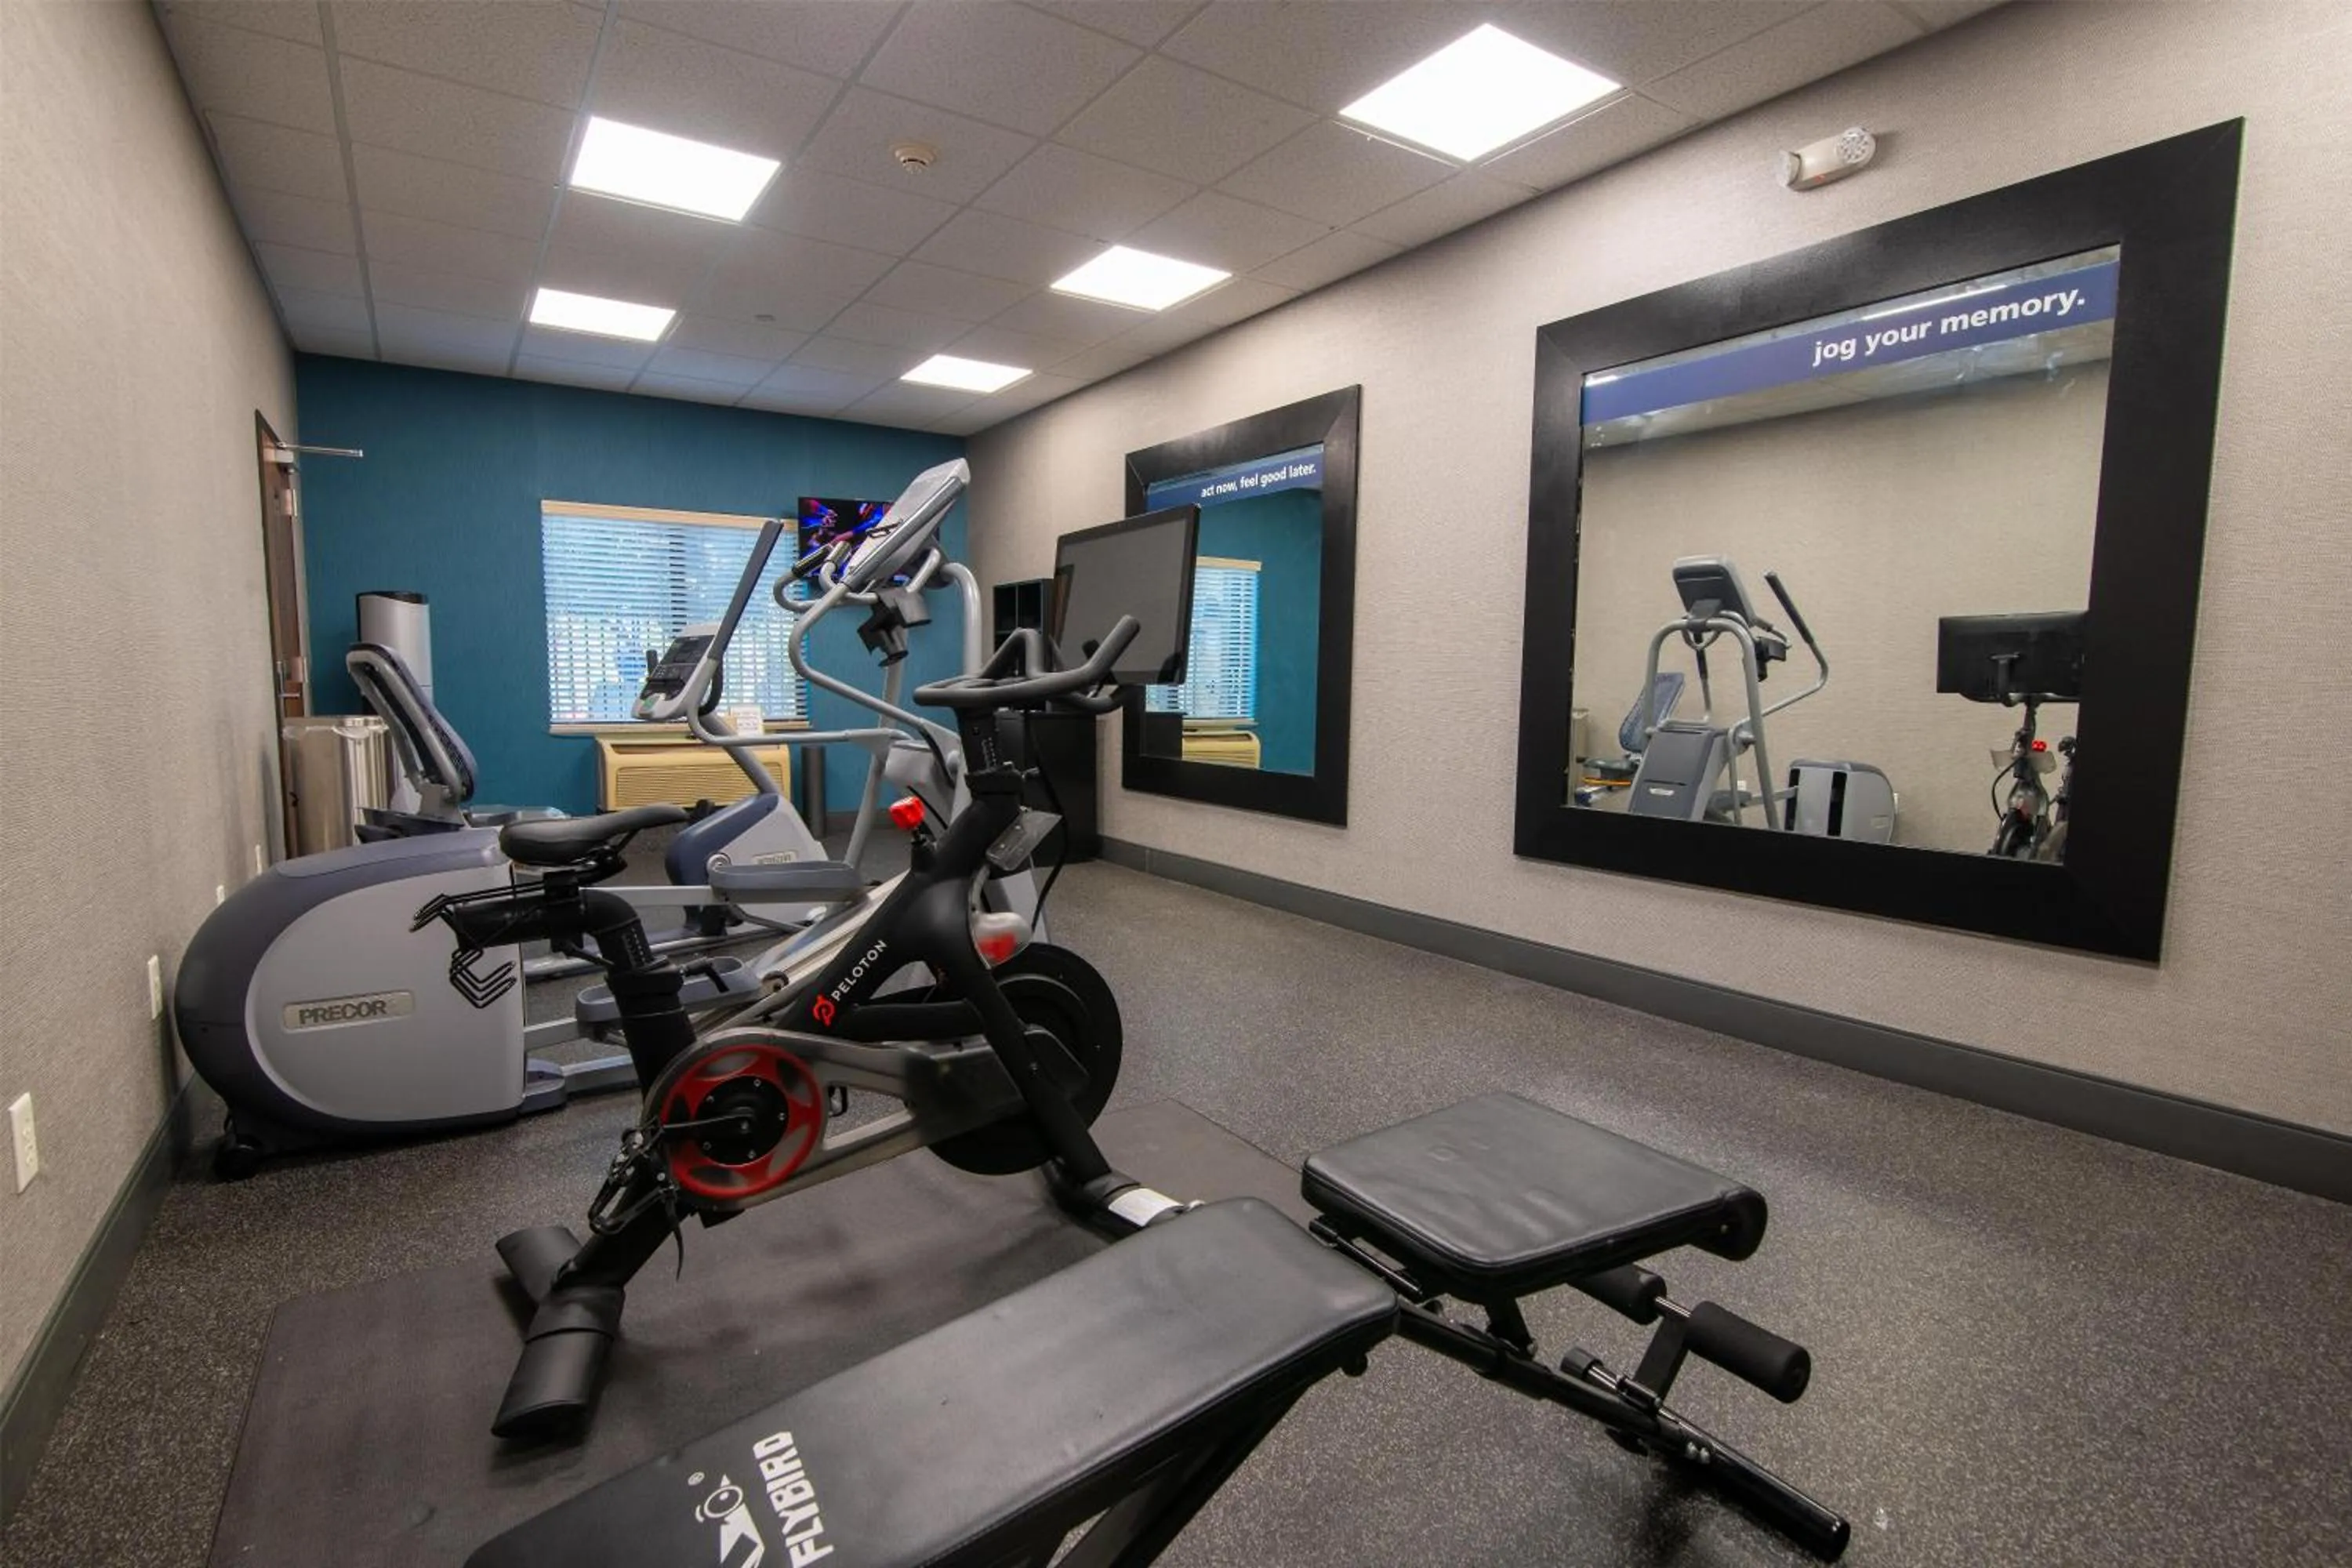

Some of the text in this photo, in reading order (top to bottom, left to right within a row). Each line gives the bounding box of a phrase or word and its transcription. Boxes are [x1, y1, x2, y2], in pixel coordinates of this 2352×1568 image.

[1812, 287, 2085, 367] jog your memory.
[1201, 463, 1316, 498] act now, feel good later.
[831, 939, 887, 1002] PELOTON
[298, 1000, 387, 1025] PRECOR
[753, 1431, 835, 1568] FLYBIRD
